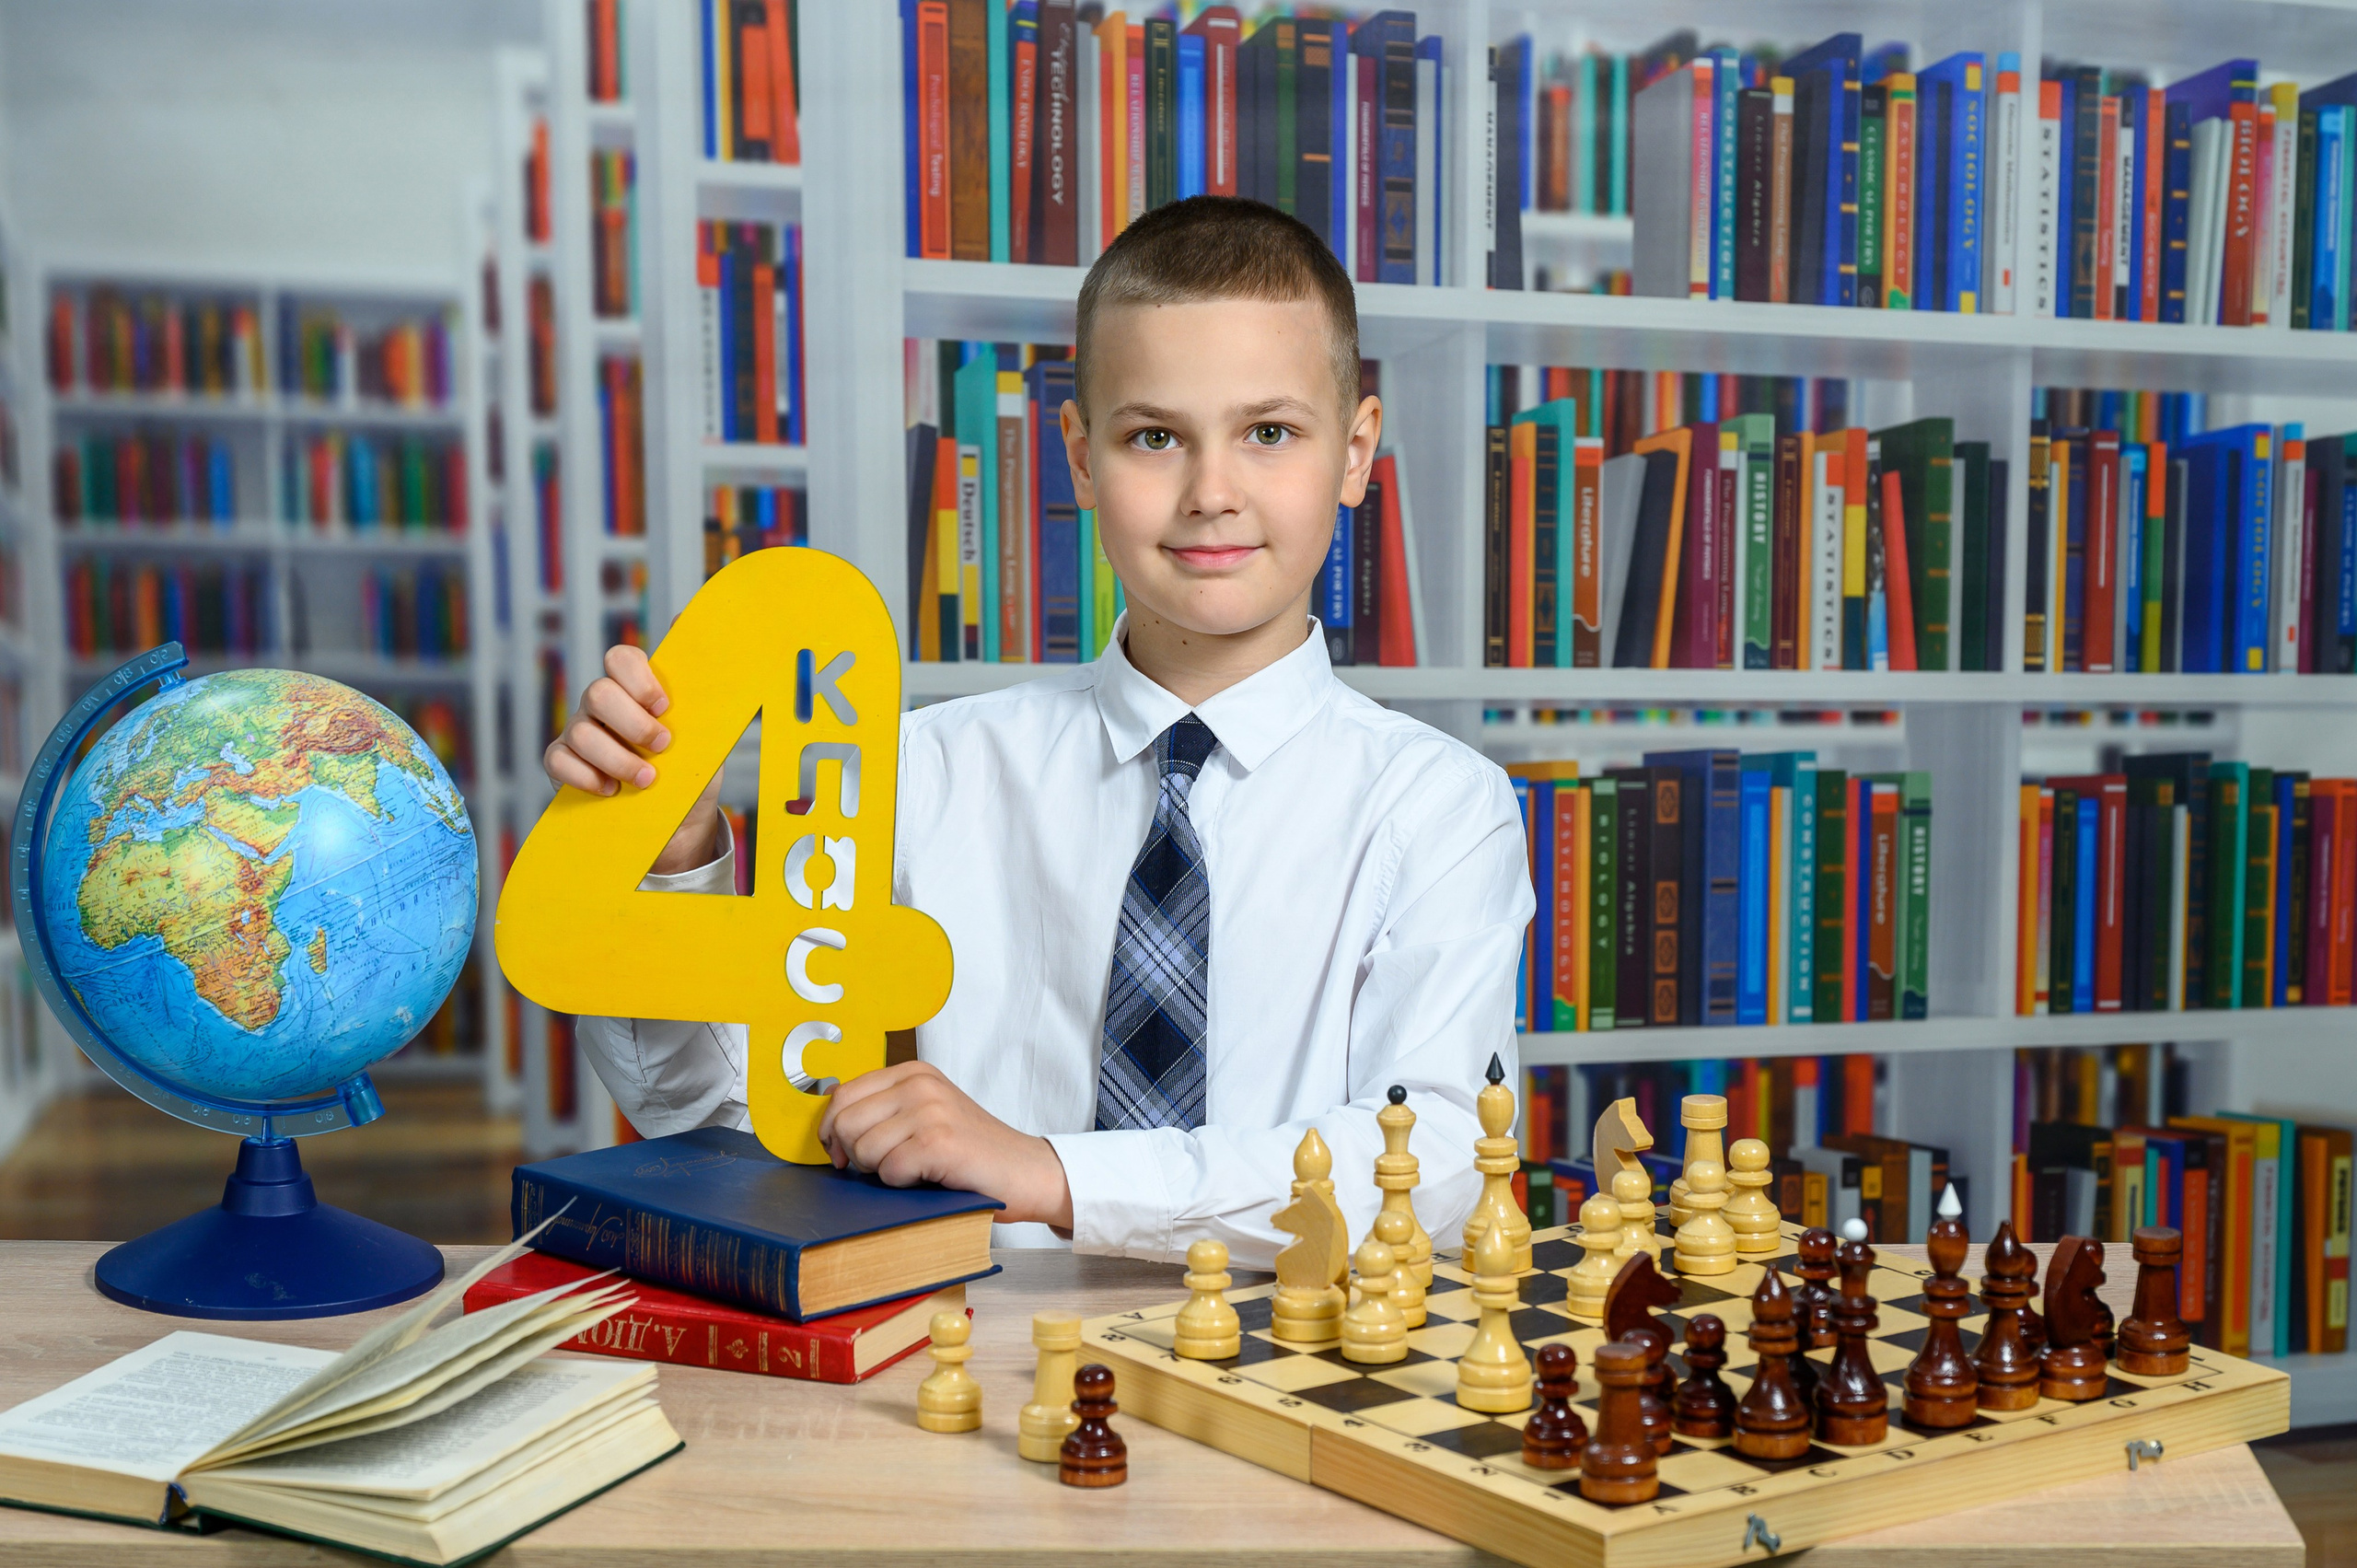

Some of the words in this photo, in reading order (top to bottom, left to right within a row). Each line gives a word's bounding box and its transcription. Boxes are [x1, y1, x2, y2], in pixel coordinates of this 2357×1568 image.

[929, 153, 943, 197] Testing
[1051, 50, 1064, 205] TECHNOLOGY
[1721, 91, 1735, 281] CONSTRUCTION
[1752, 180, 1763, 248] Algebra
[1963, 99, 1978, 254] SOCIOLOGY
[2039, 127, 2052, 309] STATISTICS
[2120, 155, 2131, 267] MANAGEMENT
[1004, 427, 1016, 453] The
[961, 482, 977, 562] Deutsch
[1003, 458, 1016, 555] Programming
[1581, 486, 1595, 578] Literature
[1753, 470, 1768, 544] HISTORY
[1361, 558, 1373, 616] Algebra
[1825, 493, 1837, 659] STATISTICS
[496, 546, 953, 1165] 4
[1560, 812, 1571, 983] PSYCHOLOGY
[1596, 814, 1608, 949] BIOLOGY
[1798, 794, 1814, 992] CONSTRUCTION
[1876, 833, 1889, 925] Literature
[1912, 826, 1926, 896] HISTORY
[1624, 880, 1636, 956] Algebra
[778, 1345, 802, 1369] 2
[1120, 1312, 1144, 1320] A
[1100, 1333, 1126, 1342] 8
[1159, 1349, 1180, 1363] 7
[1278, 1397, 1304, 1408] 5
[1404, 1440, 1432, 1452] 3
[1470, 1466, 1498, 1477] 2
[1653, 1504, 1680, 1516] A
[1729, 1485, 1759, 1496] B
[1809, 1468, 1838, 1479] C
[1883, 1449, 1915, 1461] D
[1962, 1432, 1994, 1444] E
[2037, 1414, 2061, 1426] F
[2109, 1398, 2138, 1409] G
[2181, 1380, 2217, 1393] H
